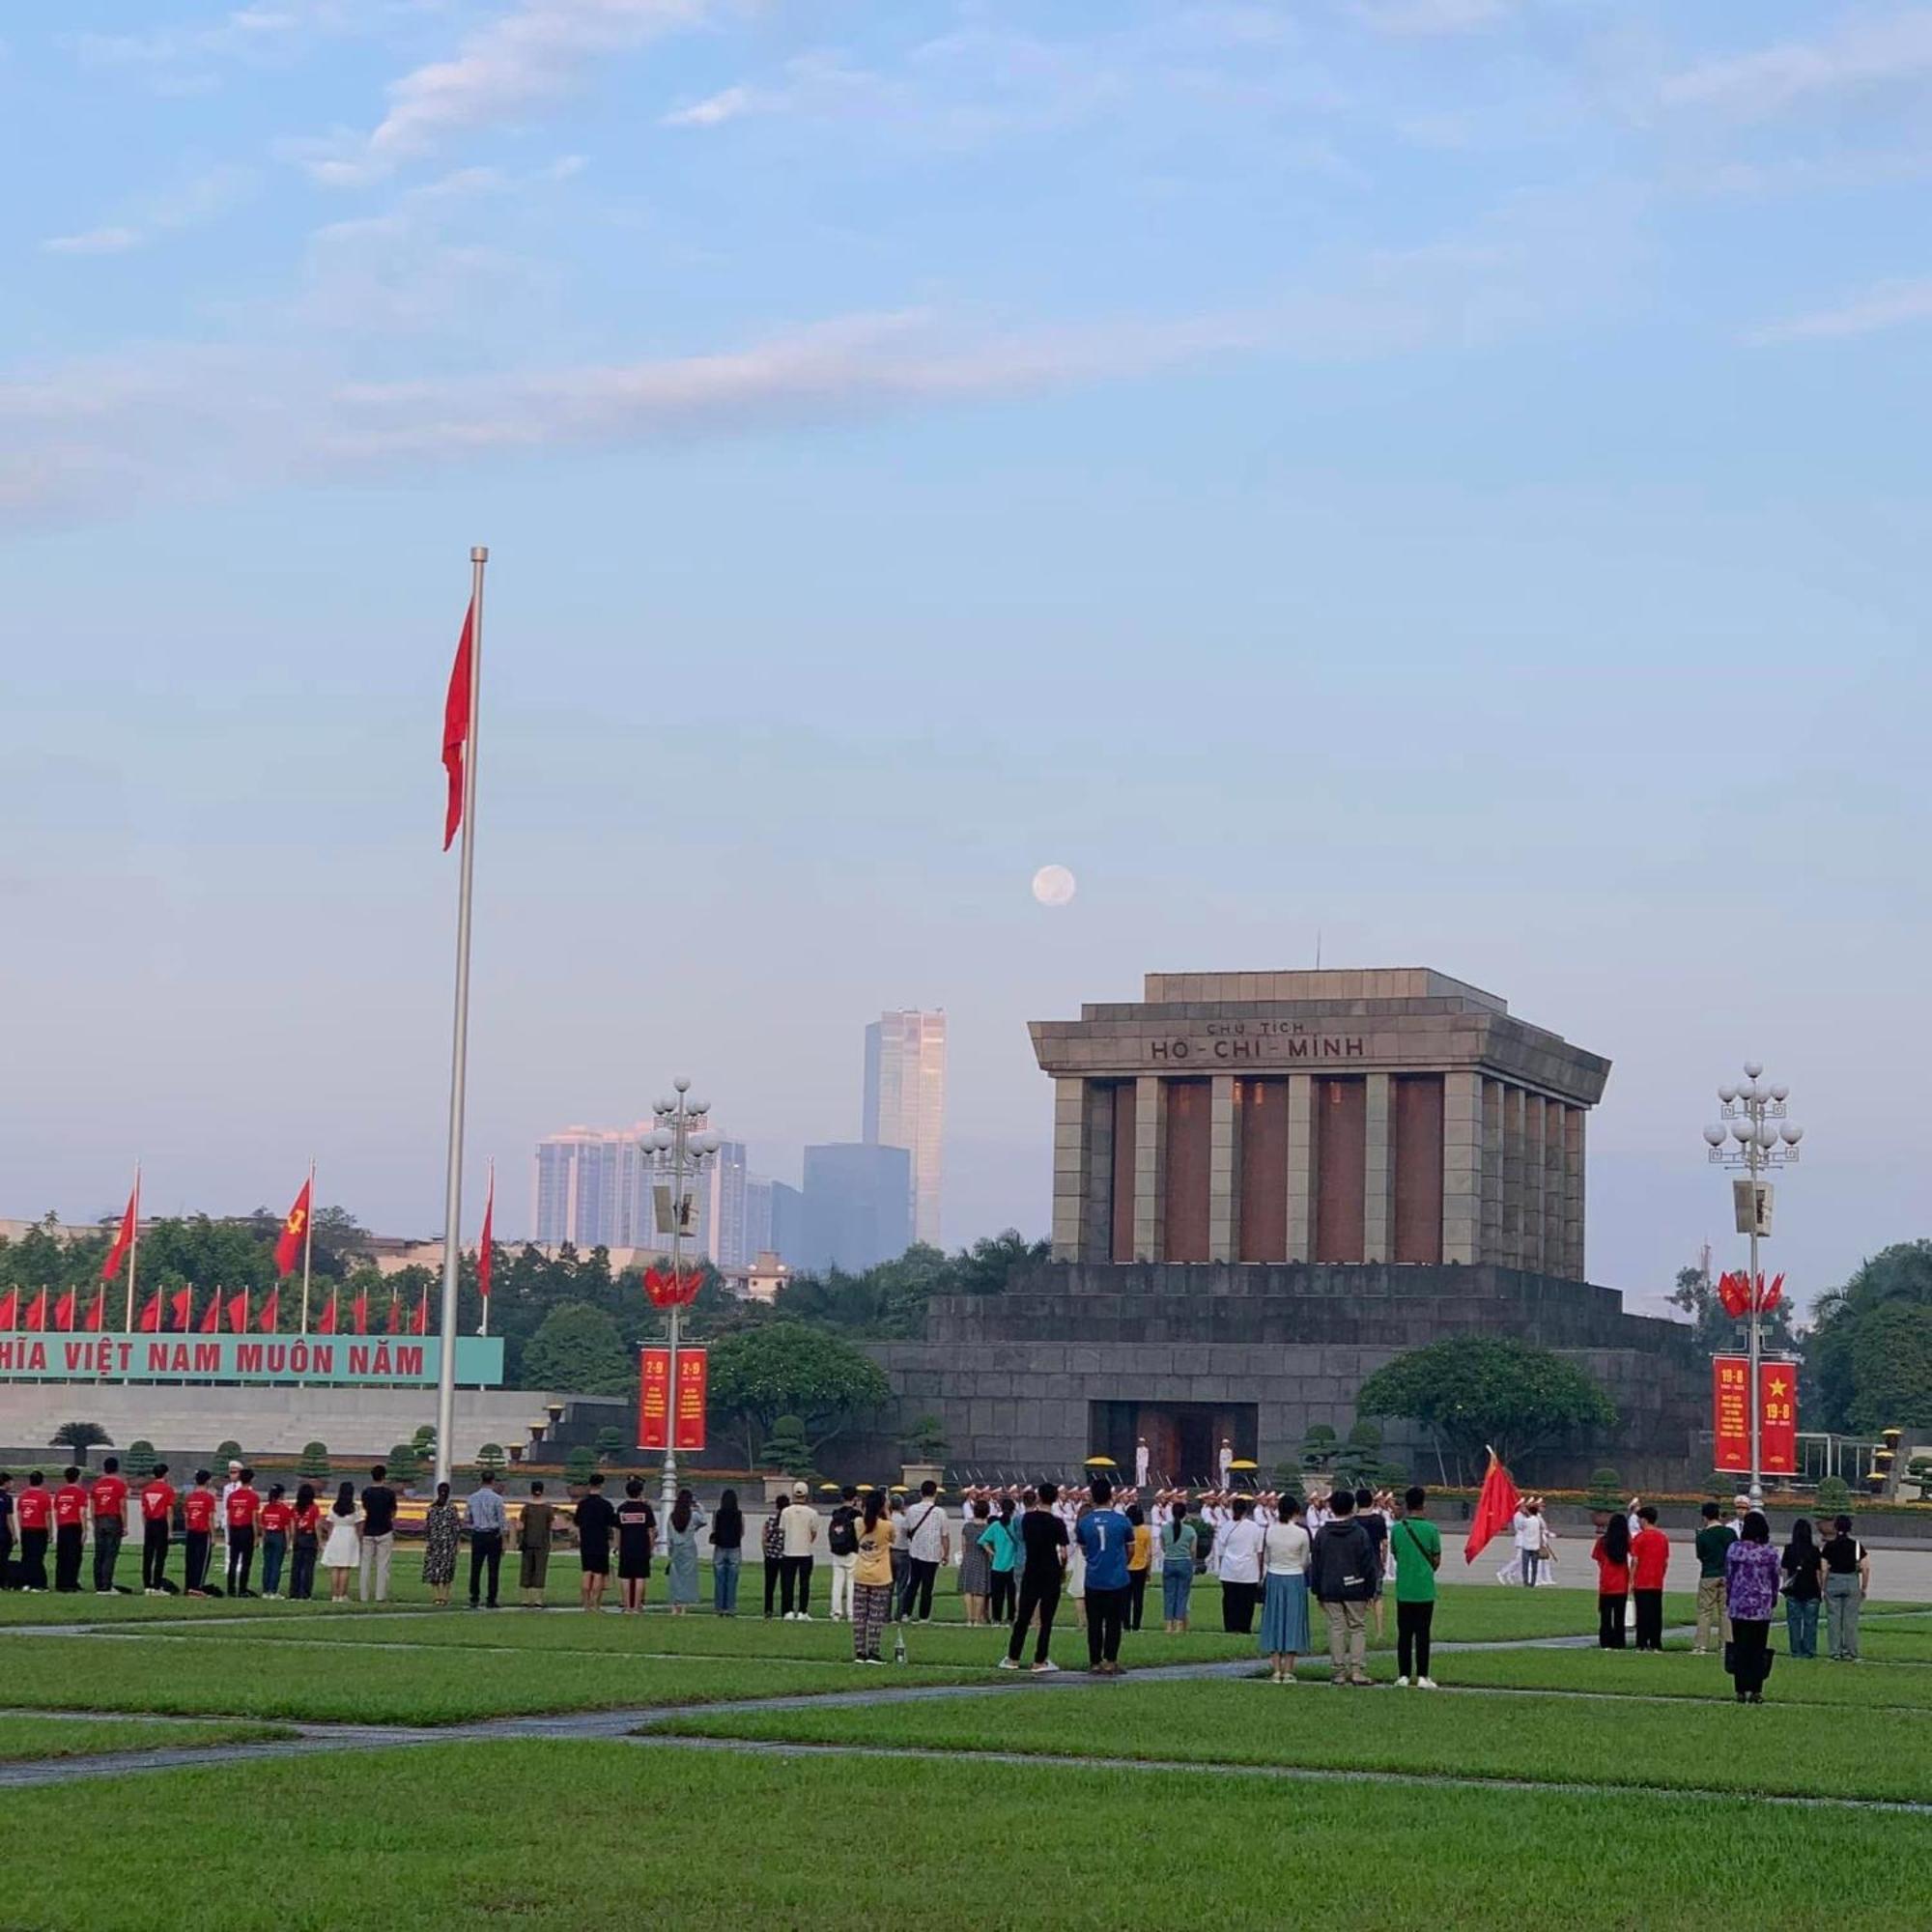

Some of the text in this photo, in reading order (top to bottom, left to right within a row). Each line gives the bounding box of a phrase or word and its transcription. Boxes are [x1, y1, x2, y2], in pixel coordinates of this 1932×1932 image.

[64, 1337, 133, 1376] VIỆT
[148, 1343, 220, 1372] NAM
[237, 1339, 333, 1374] MUÔN
[349, 1339, 423, 1376] NĂM
[1097, 1524, 1105, 1550] 1
